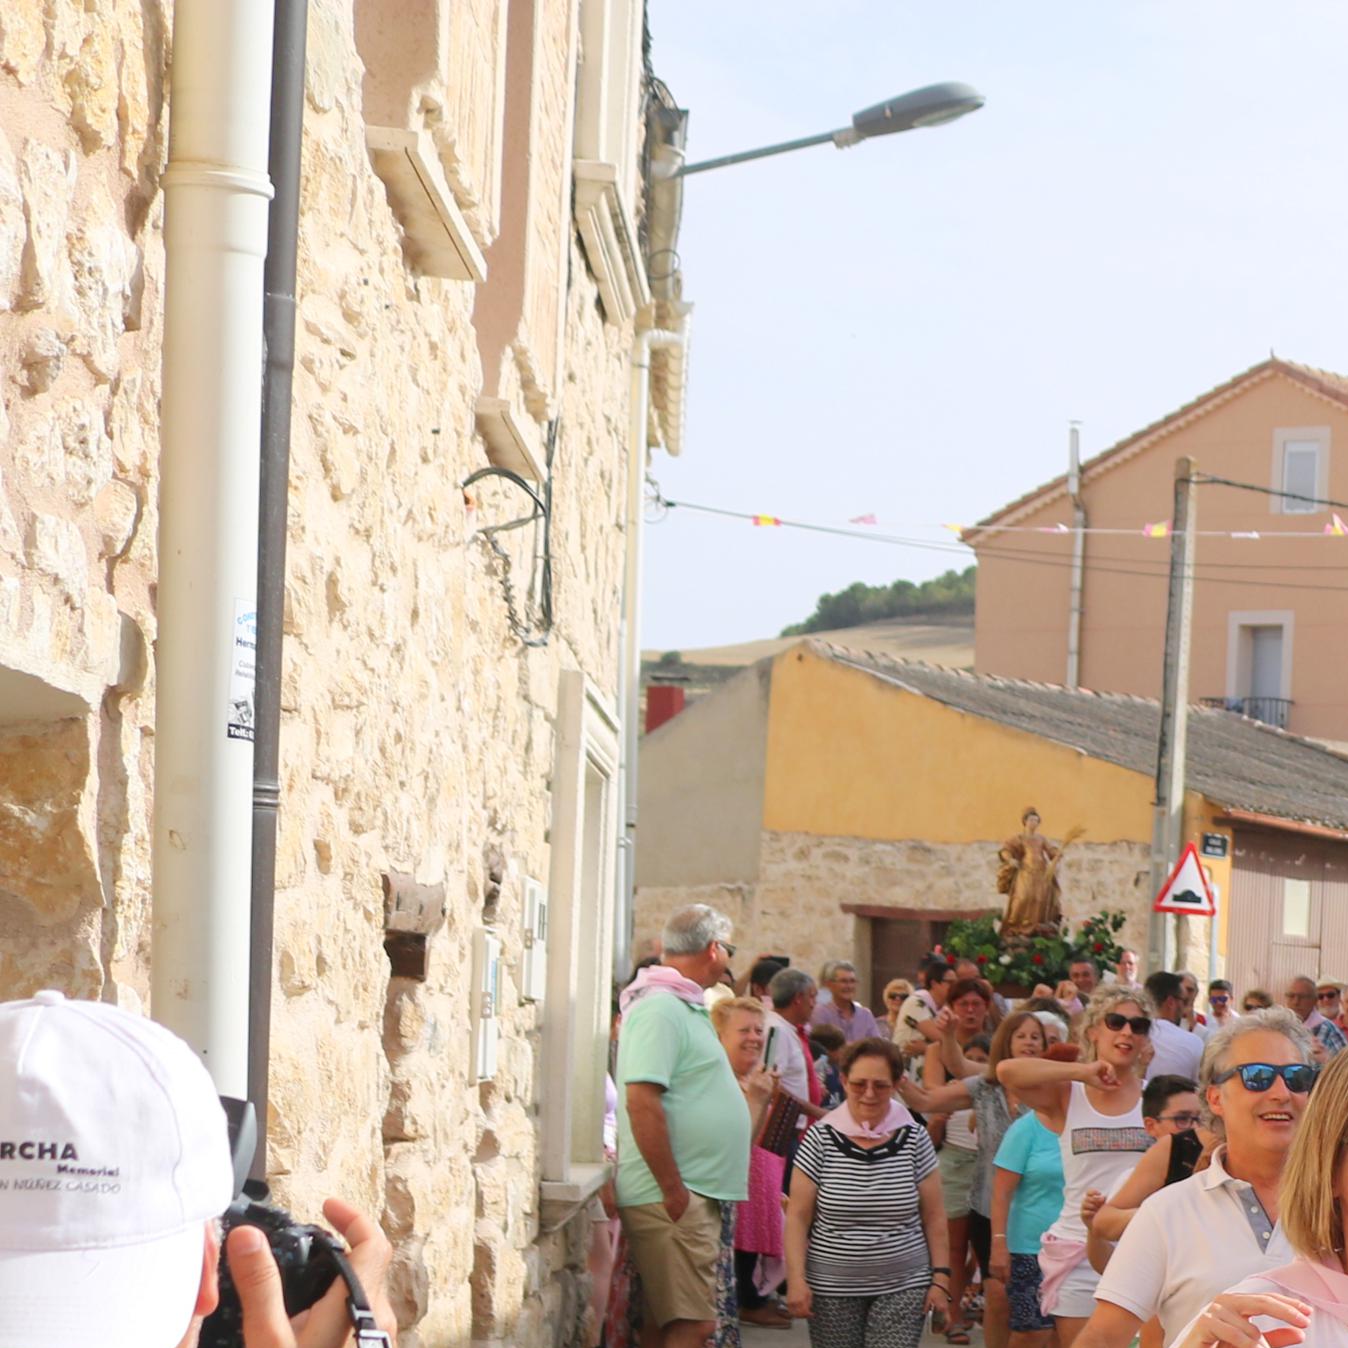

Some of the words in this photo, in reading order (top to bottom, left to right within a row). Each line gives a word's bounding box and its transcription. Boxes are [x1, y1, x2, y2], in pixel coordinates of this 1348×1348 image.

[0, 1142, 79, 1161] RCHA
[56, 1164, 120, 1177] Memorial
[65, 1180, 122, 1194] CASADO
